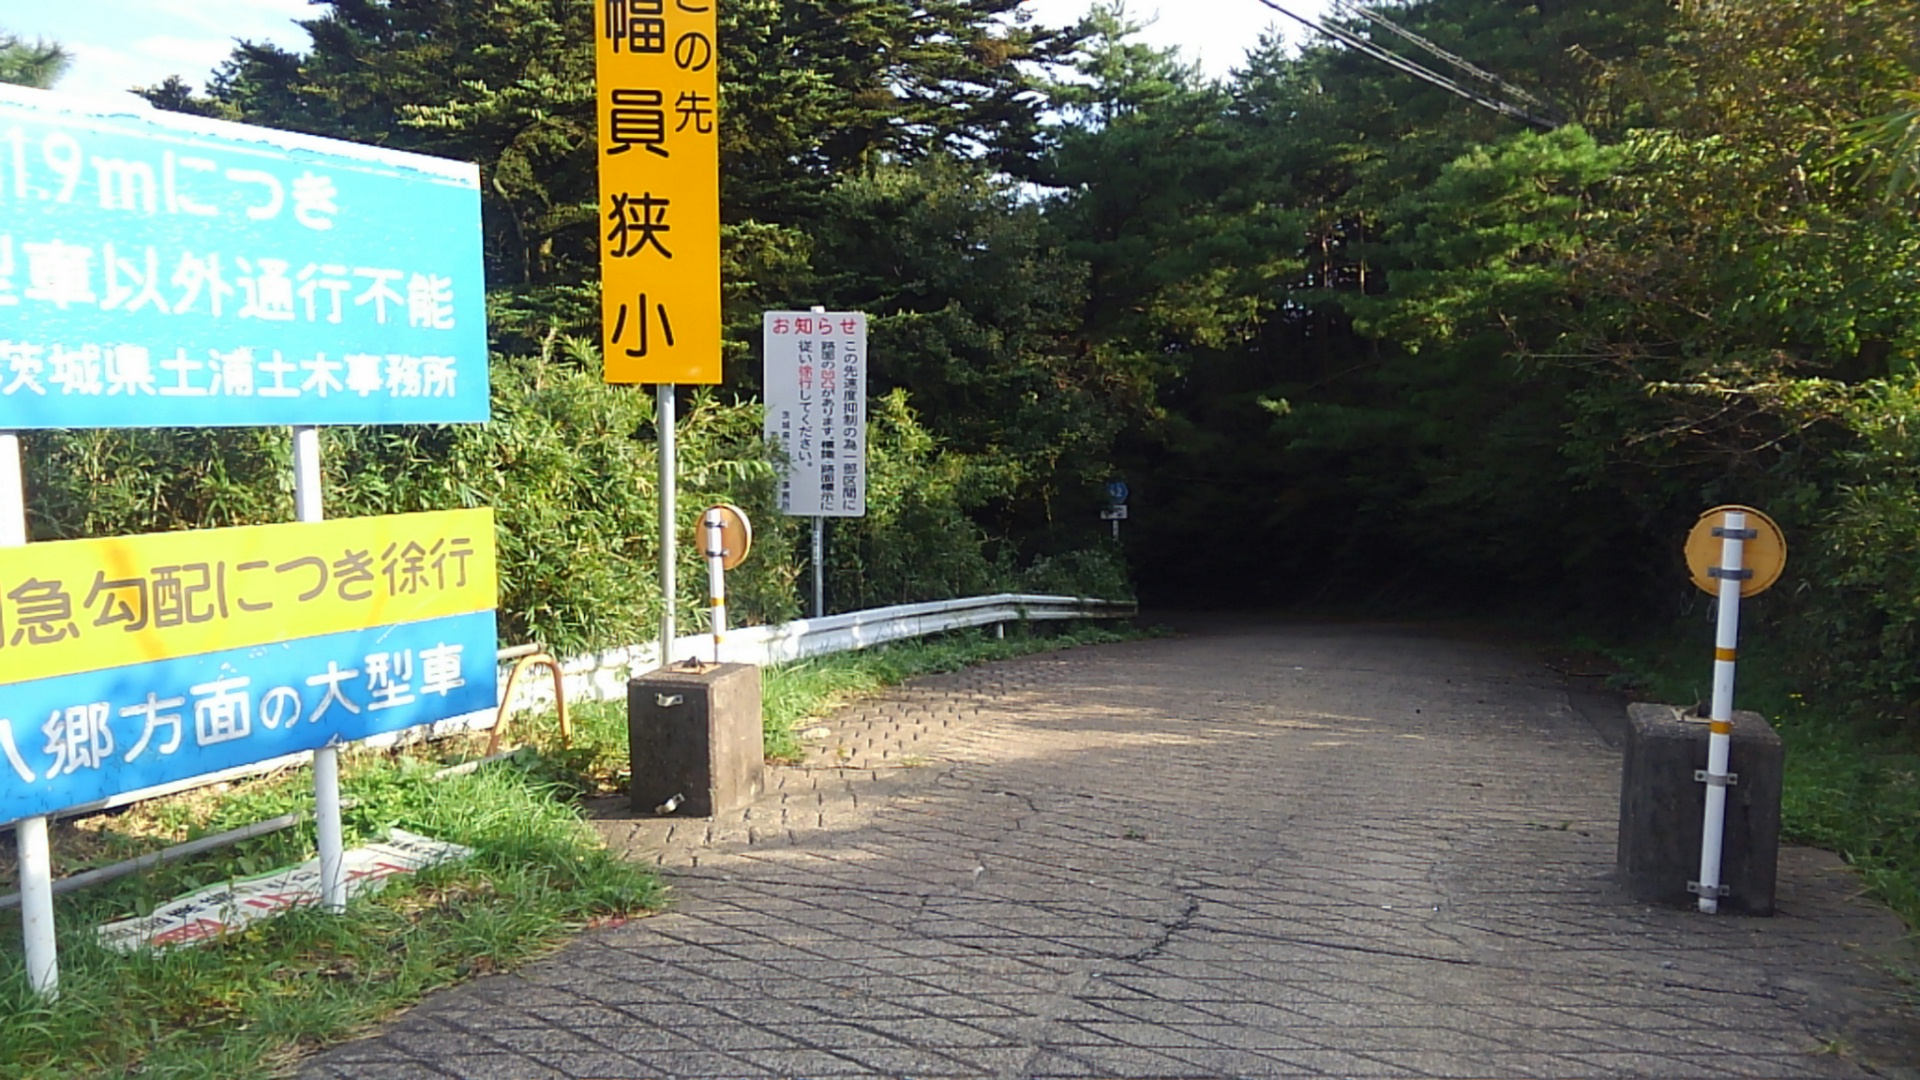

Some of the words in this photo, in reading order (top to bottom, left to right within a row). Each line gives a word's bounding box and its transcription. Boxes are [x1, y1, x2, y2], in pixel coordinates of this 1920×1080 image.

[605, 0, 675, 357] 幅員狭小
[0, 339, 457, 398] 茨城県土浦土木事務所
[772, 317, 858, 336] お知らせ
[0, 537, 474, 648] 急勾配につき徐行
